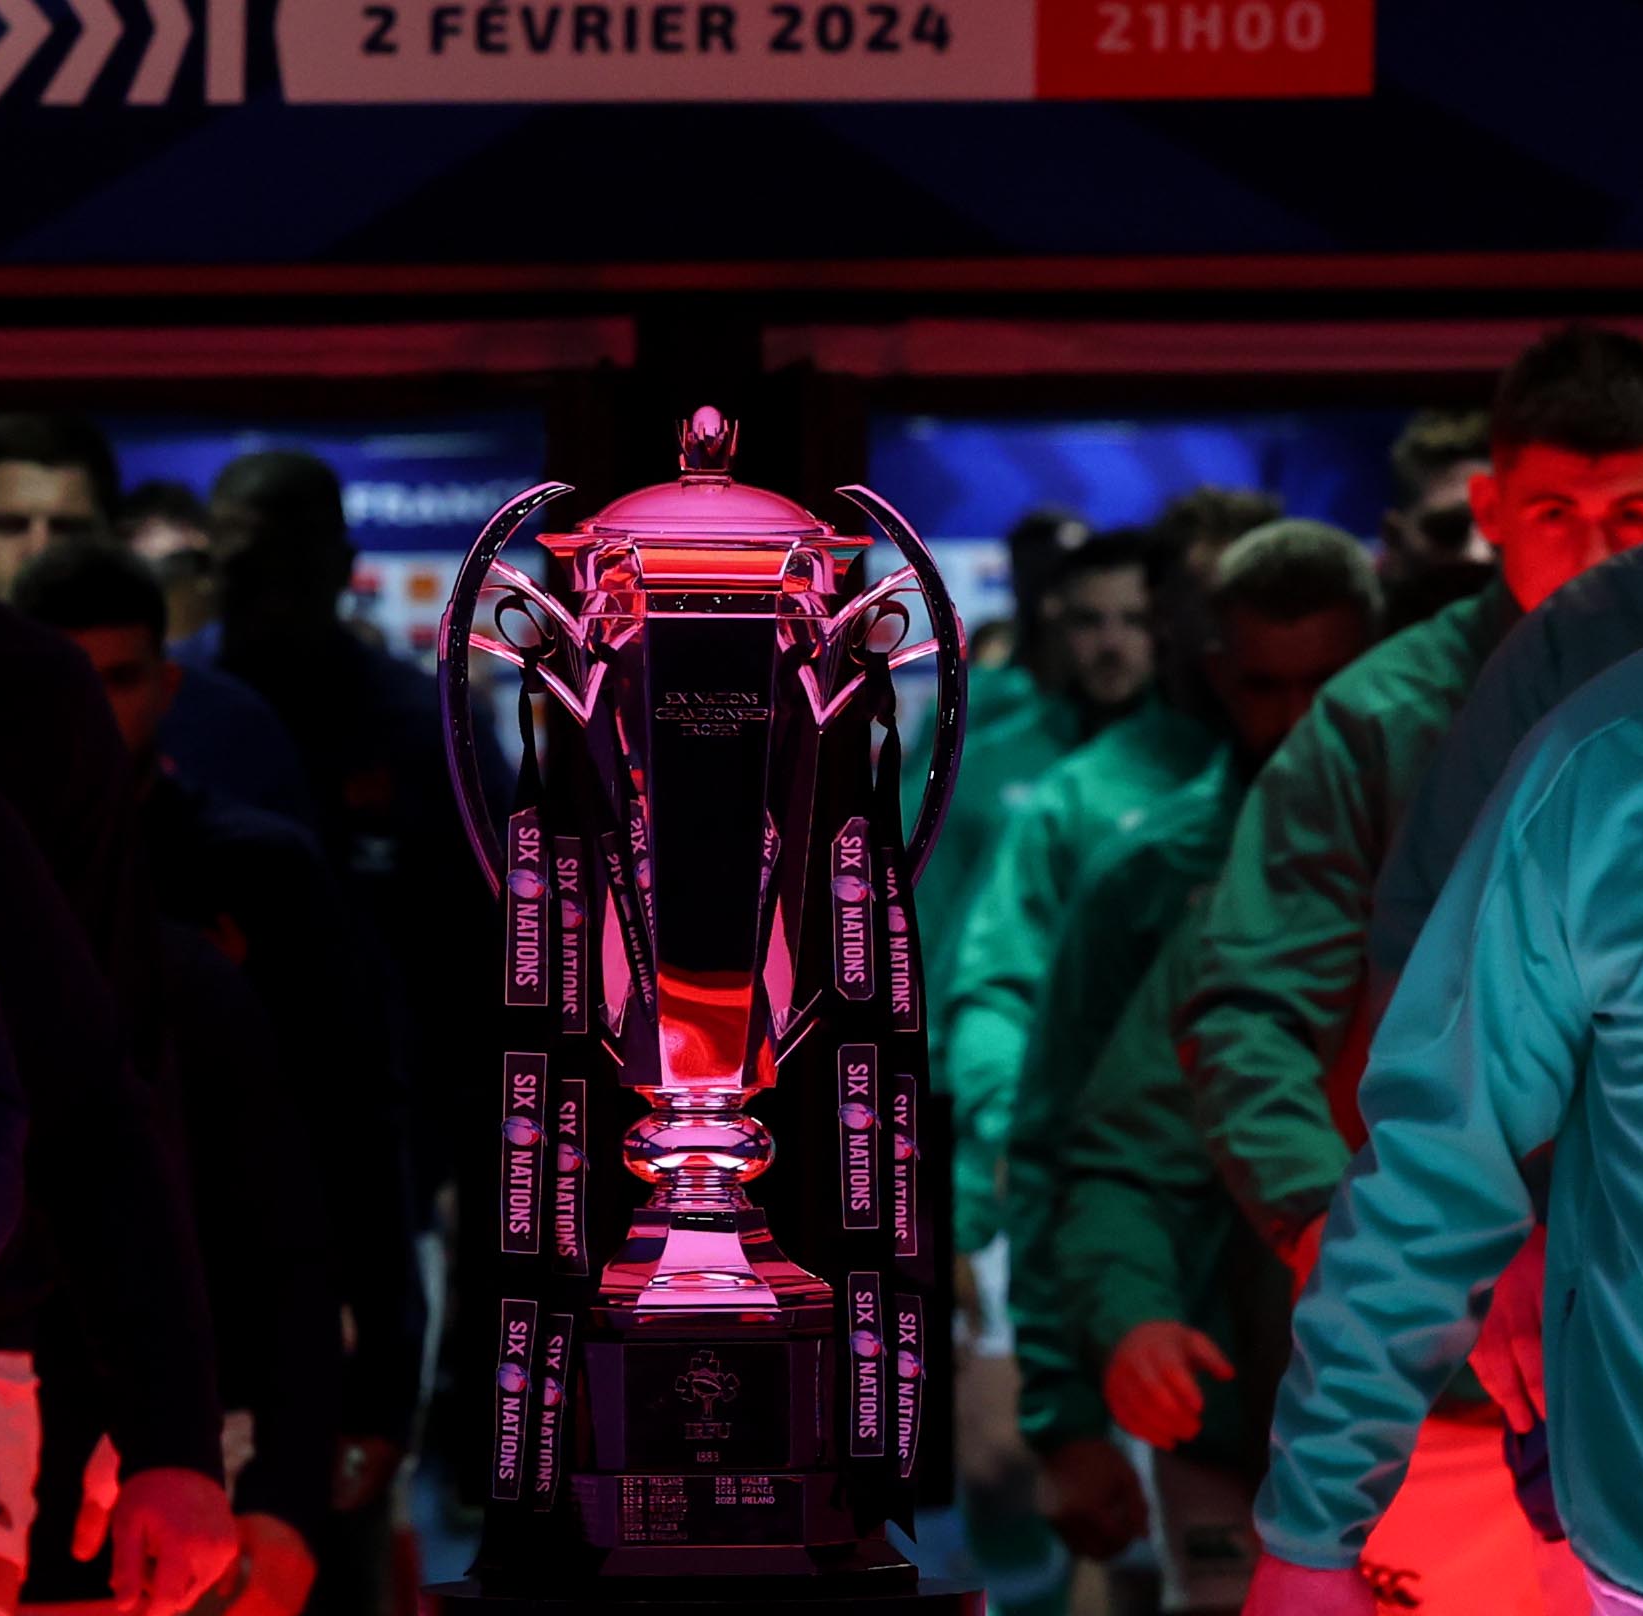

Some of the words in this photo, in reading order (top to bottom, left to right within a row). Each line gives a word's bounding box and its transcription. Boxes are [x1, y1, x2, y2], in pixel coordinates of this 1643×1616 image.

[364, 7, 397, 53] 2
[430, 0, 736, 53] FÉVRIER
[769, 6, 949, 52] 2024
[1093, 2, 1326, 53] 21H00
[518, 827, 540, 863] SIX
[840, 836, 862, 869] SIX
[556, 857, 578, 892] SIX
[515, 903, 538, 987] NATIONS
[842, 906, 865, 983] NATIONS
[889, 936, 910, 1014] NATIONS
[512, 1073, 537, 1110] SIX
[847, 1063, 868, 1097] SIX
[558, 1101, 577, 1136] SIX
[509, 1151, 533, 1234] NATIONS
[849, 1134, 870, 1211] NATIONS
[555, 1177, 578, 1257] NATIONS
[855, 1291, 874, 1324] SIX
[898, 1312, 916, 1345] SIX
[506, 1320, 528, 1357] SIX
[545, 1335, 563, 1370] SIX
[858, 1362, 877, 1439] NATIONS
[898, 1383, 914, 1460] NATIONS
[499, 1397, 520, 1480] NATIONS
[534, 1411, 556, 1493] NATIONS
[742, 1486, 774, 1495] FRANCE
[742, 1496, 776, 1504] IRELAND
